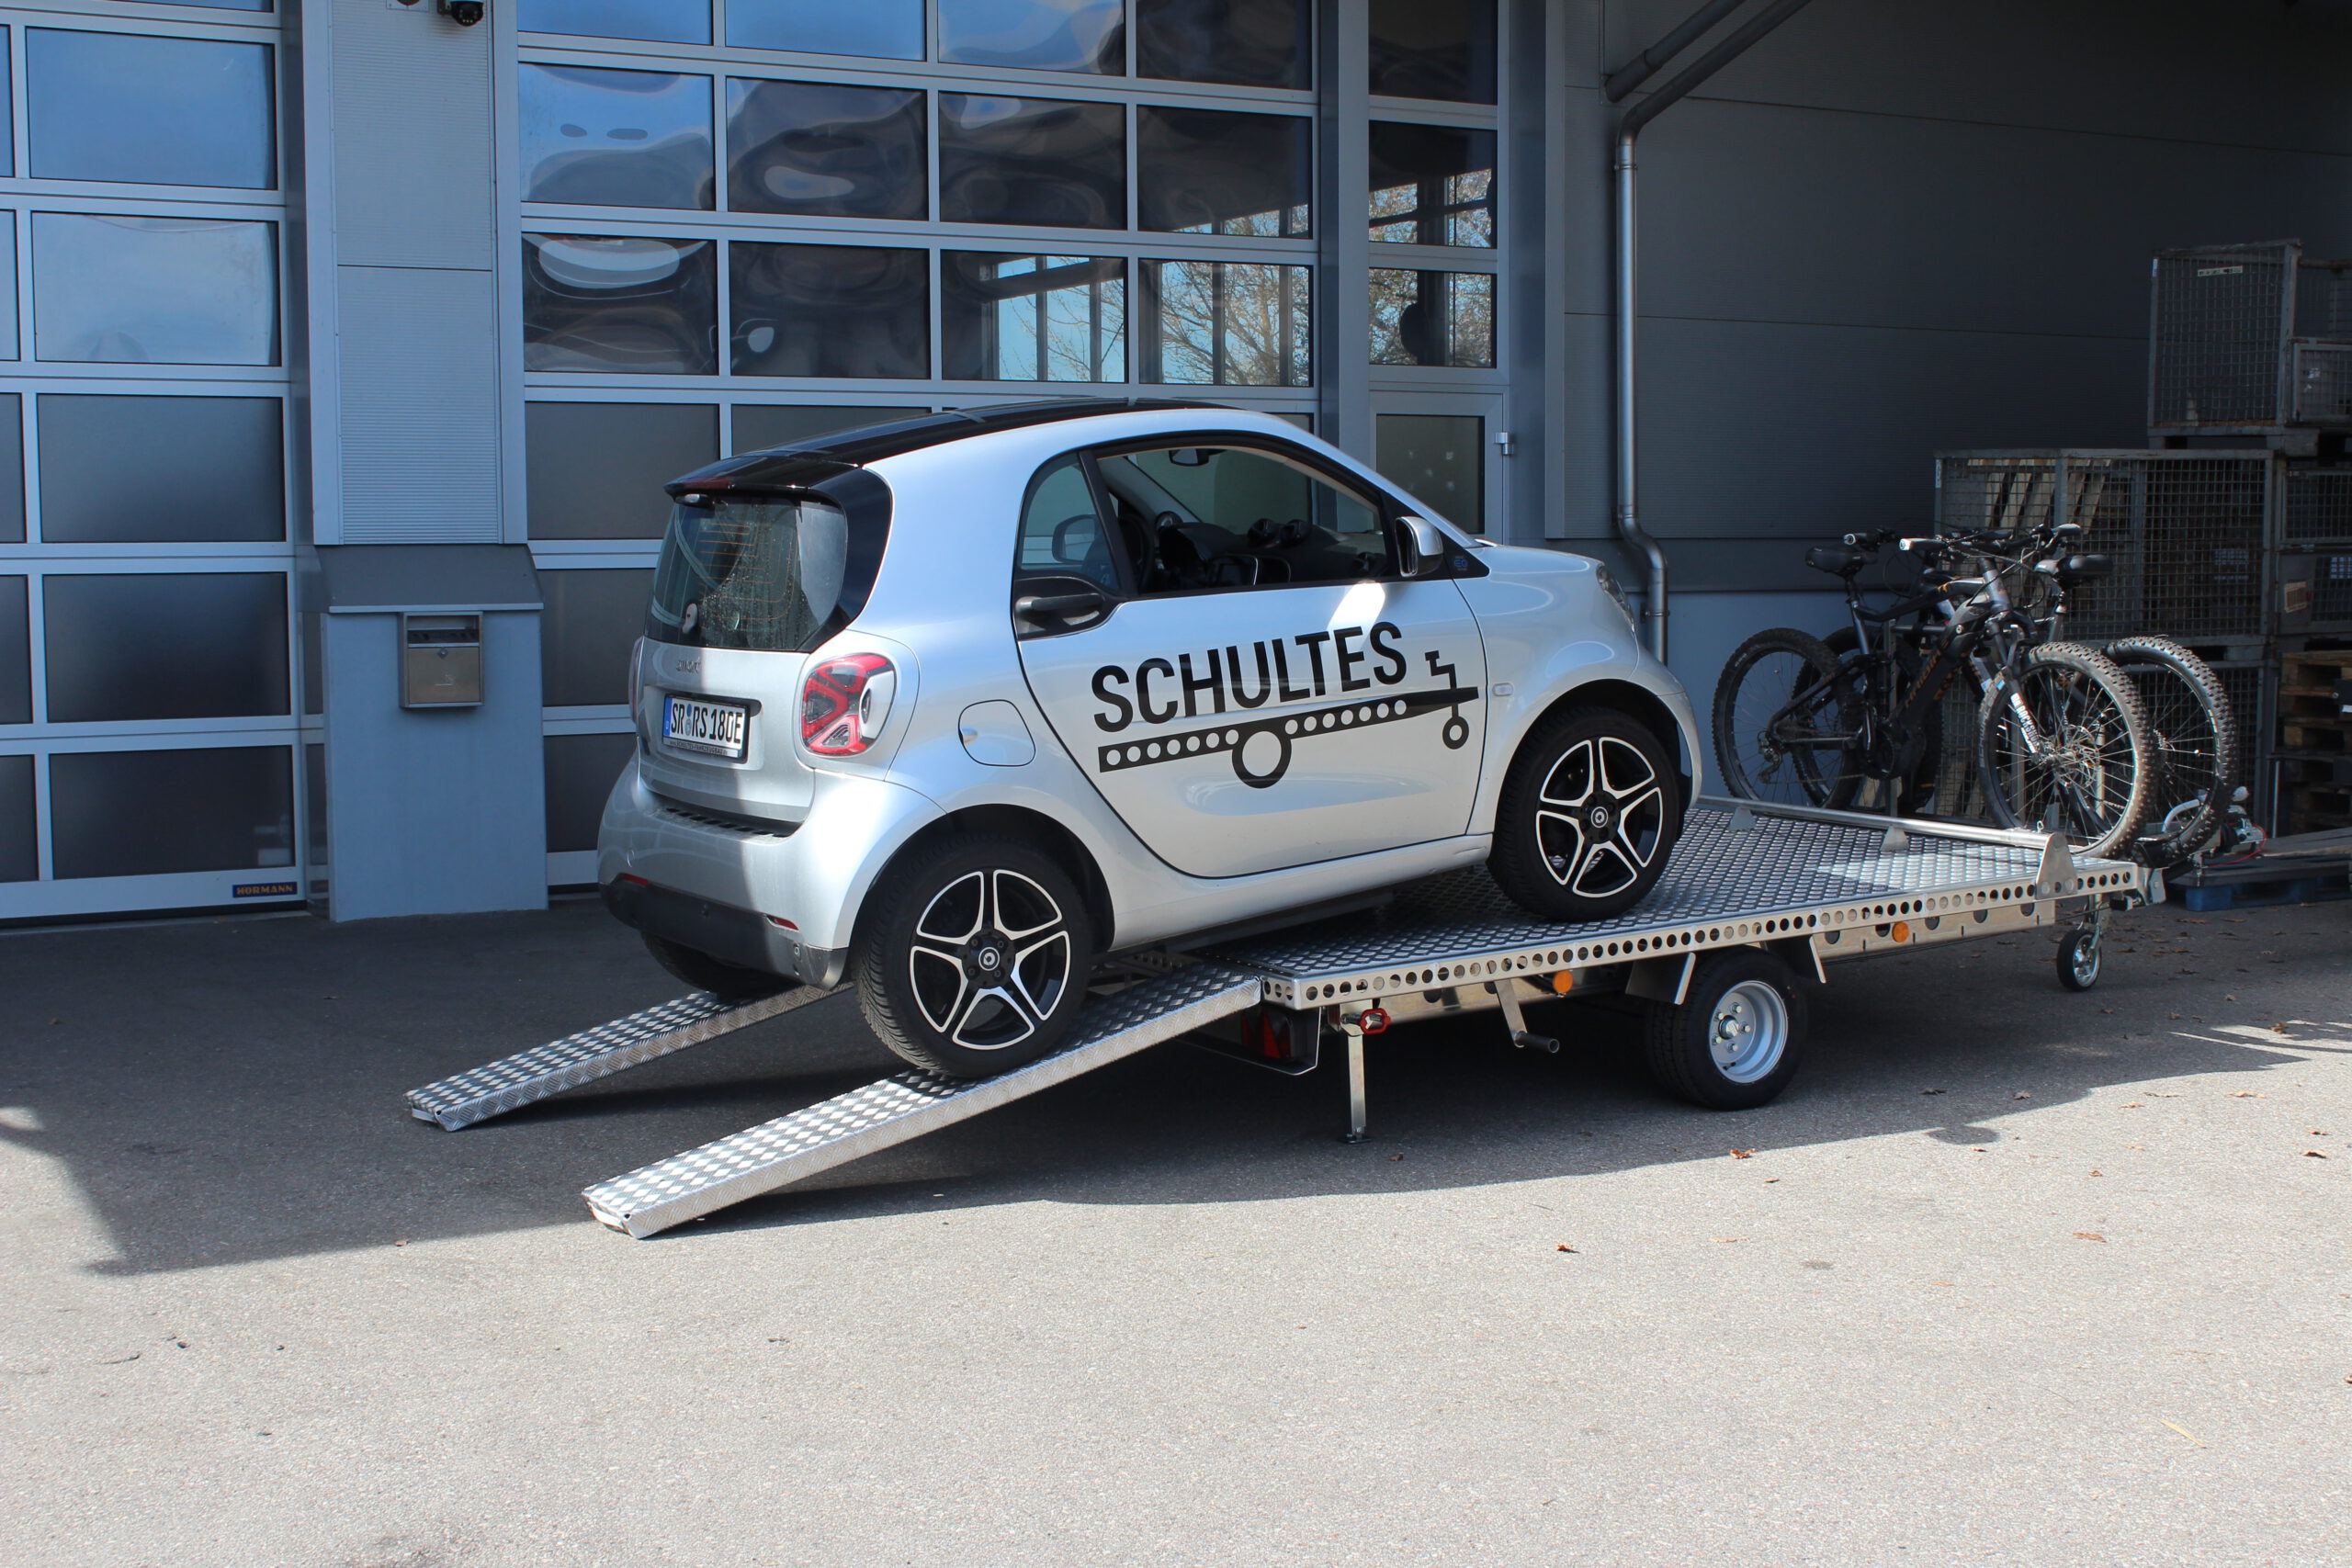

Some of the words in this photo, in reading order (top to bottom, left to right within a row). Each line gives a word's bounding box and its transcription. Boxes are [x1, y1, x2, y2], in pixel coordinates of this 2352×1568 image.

[1091, 621, 1407, 732] SCHULTES
[672, 703, 685, 735] SR
[692, 707, 707, 738] RS
[710, 709, 742, 743] 180E
